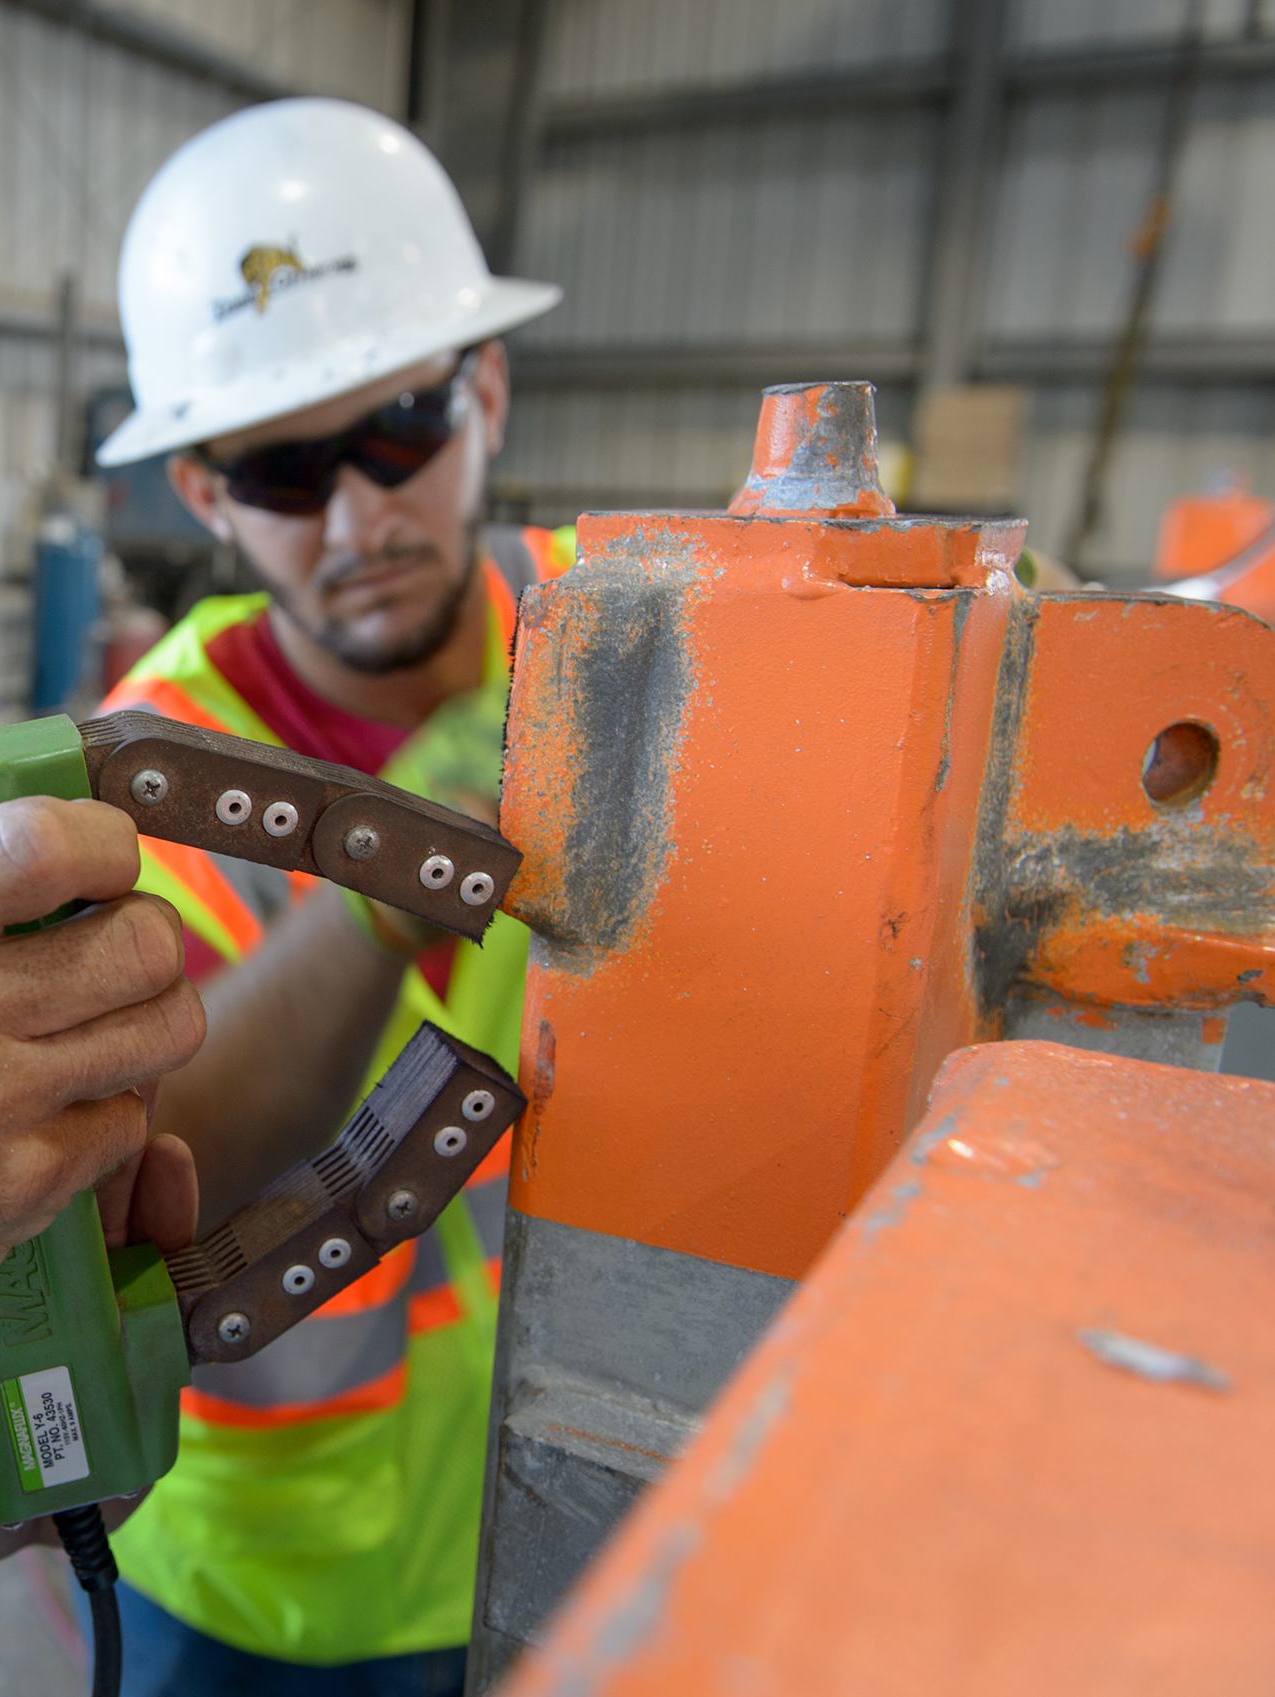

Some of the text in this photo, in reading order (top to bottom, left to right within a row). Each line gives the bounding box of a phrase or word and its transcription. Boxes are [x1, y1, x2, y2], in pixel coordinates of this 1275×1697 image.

[32, 1412, 54, 1468] MODEL Y-6
[40, 1391, 65, 1461] PT. NO. 43530
